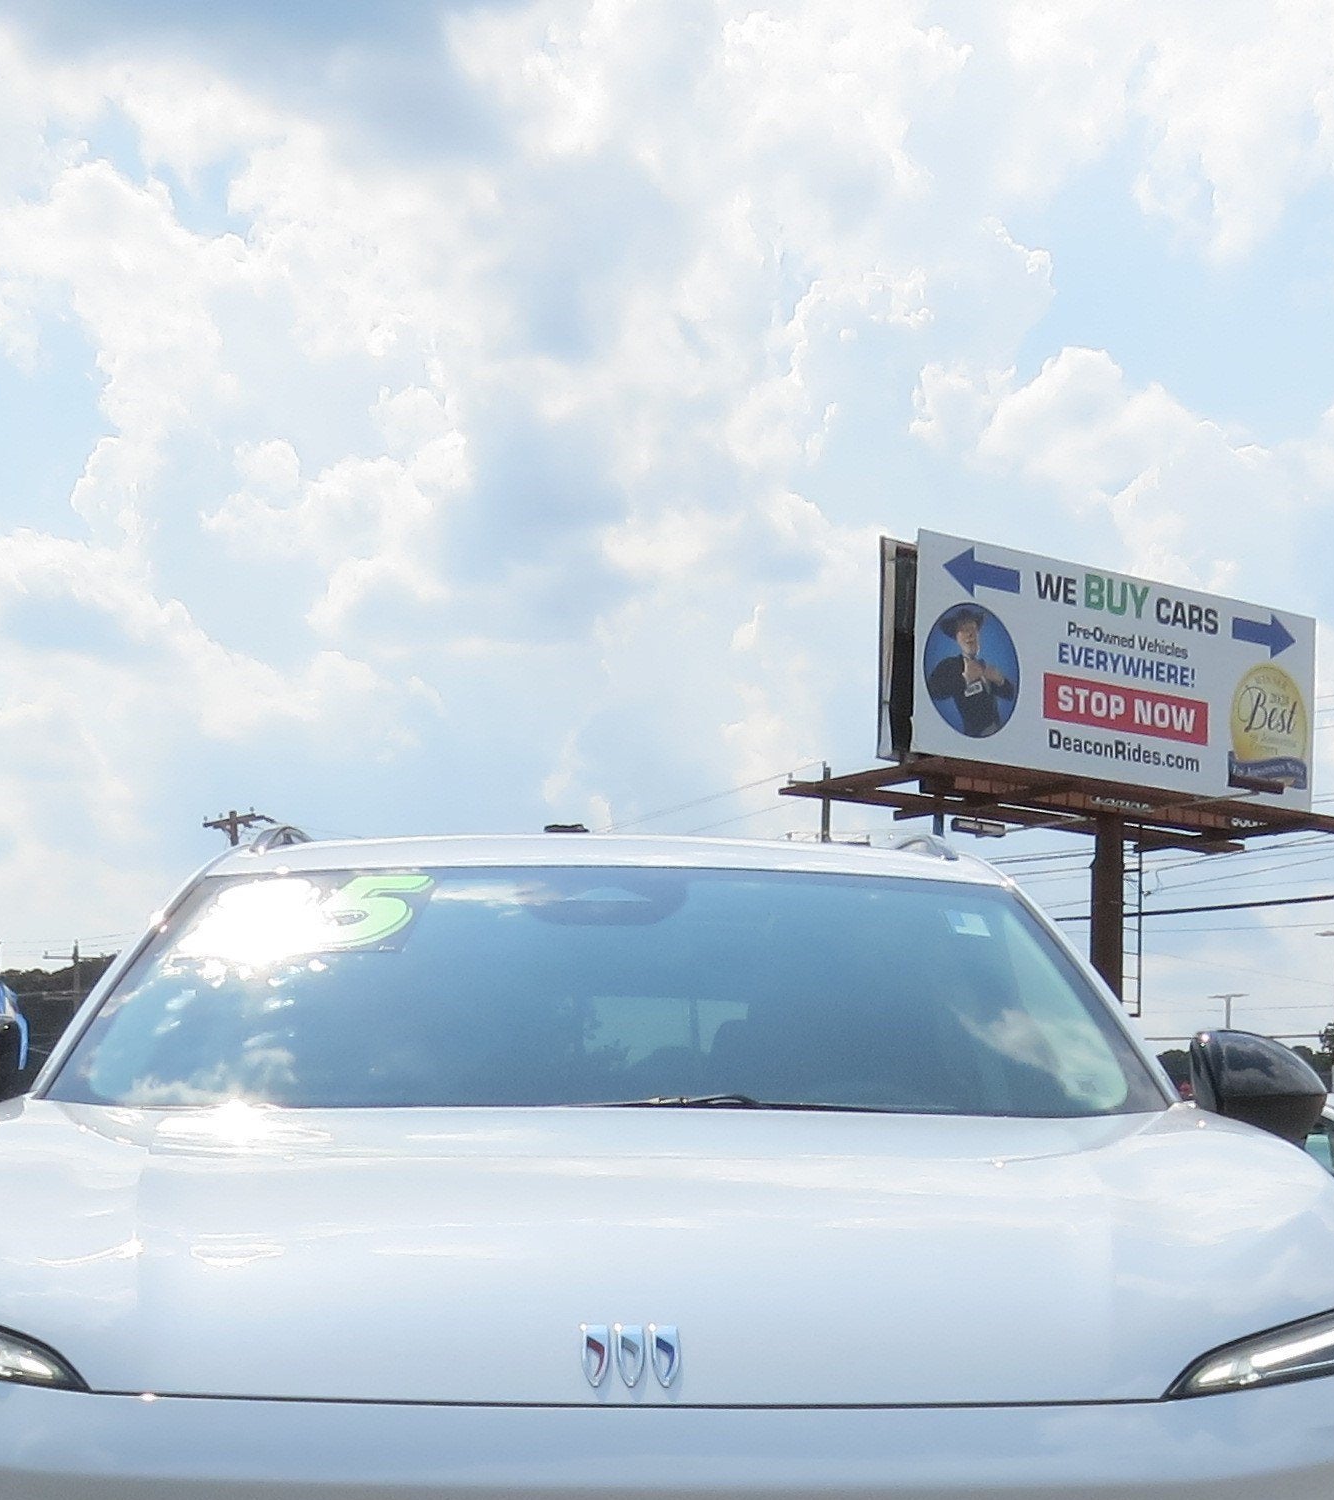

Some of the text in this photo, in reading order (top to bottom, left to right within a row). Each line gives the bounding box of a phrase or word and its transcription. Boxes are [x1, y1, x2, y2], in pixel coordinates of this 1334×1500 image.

[1035, 571, 1219, 635] WE BUY CARS
[1067, 621, 1189, 660] Pre-Owned Vehicles
[1058, 642, 1196, 688] EVERYWHERE!
[1057, 684, 1196, 734] STOP NOW
[1238, 686, 1298, 734] Best
[1048, 728, 1200, 772] DeaconRides.com
